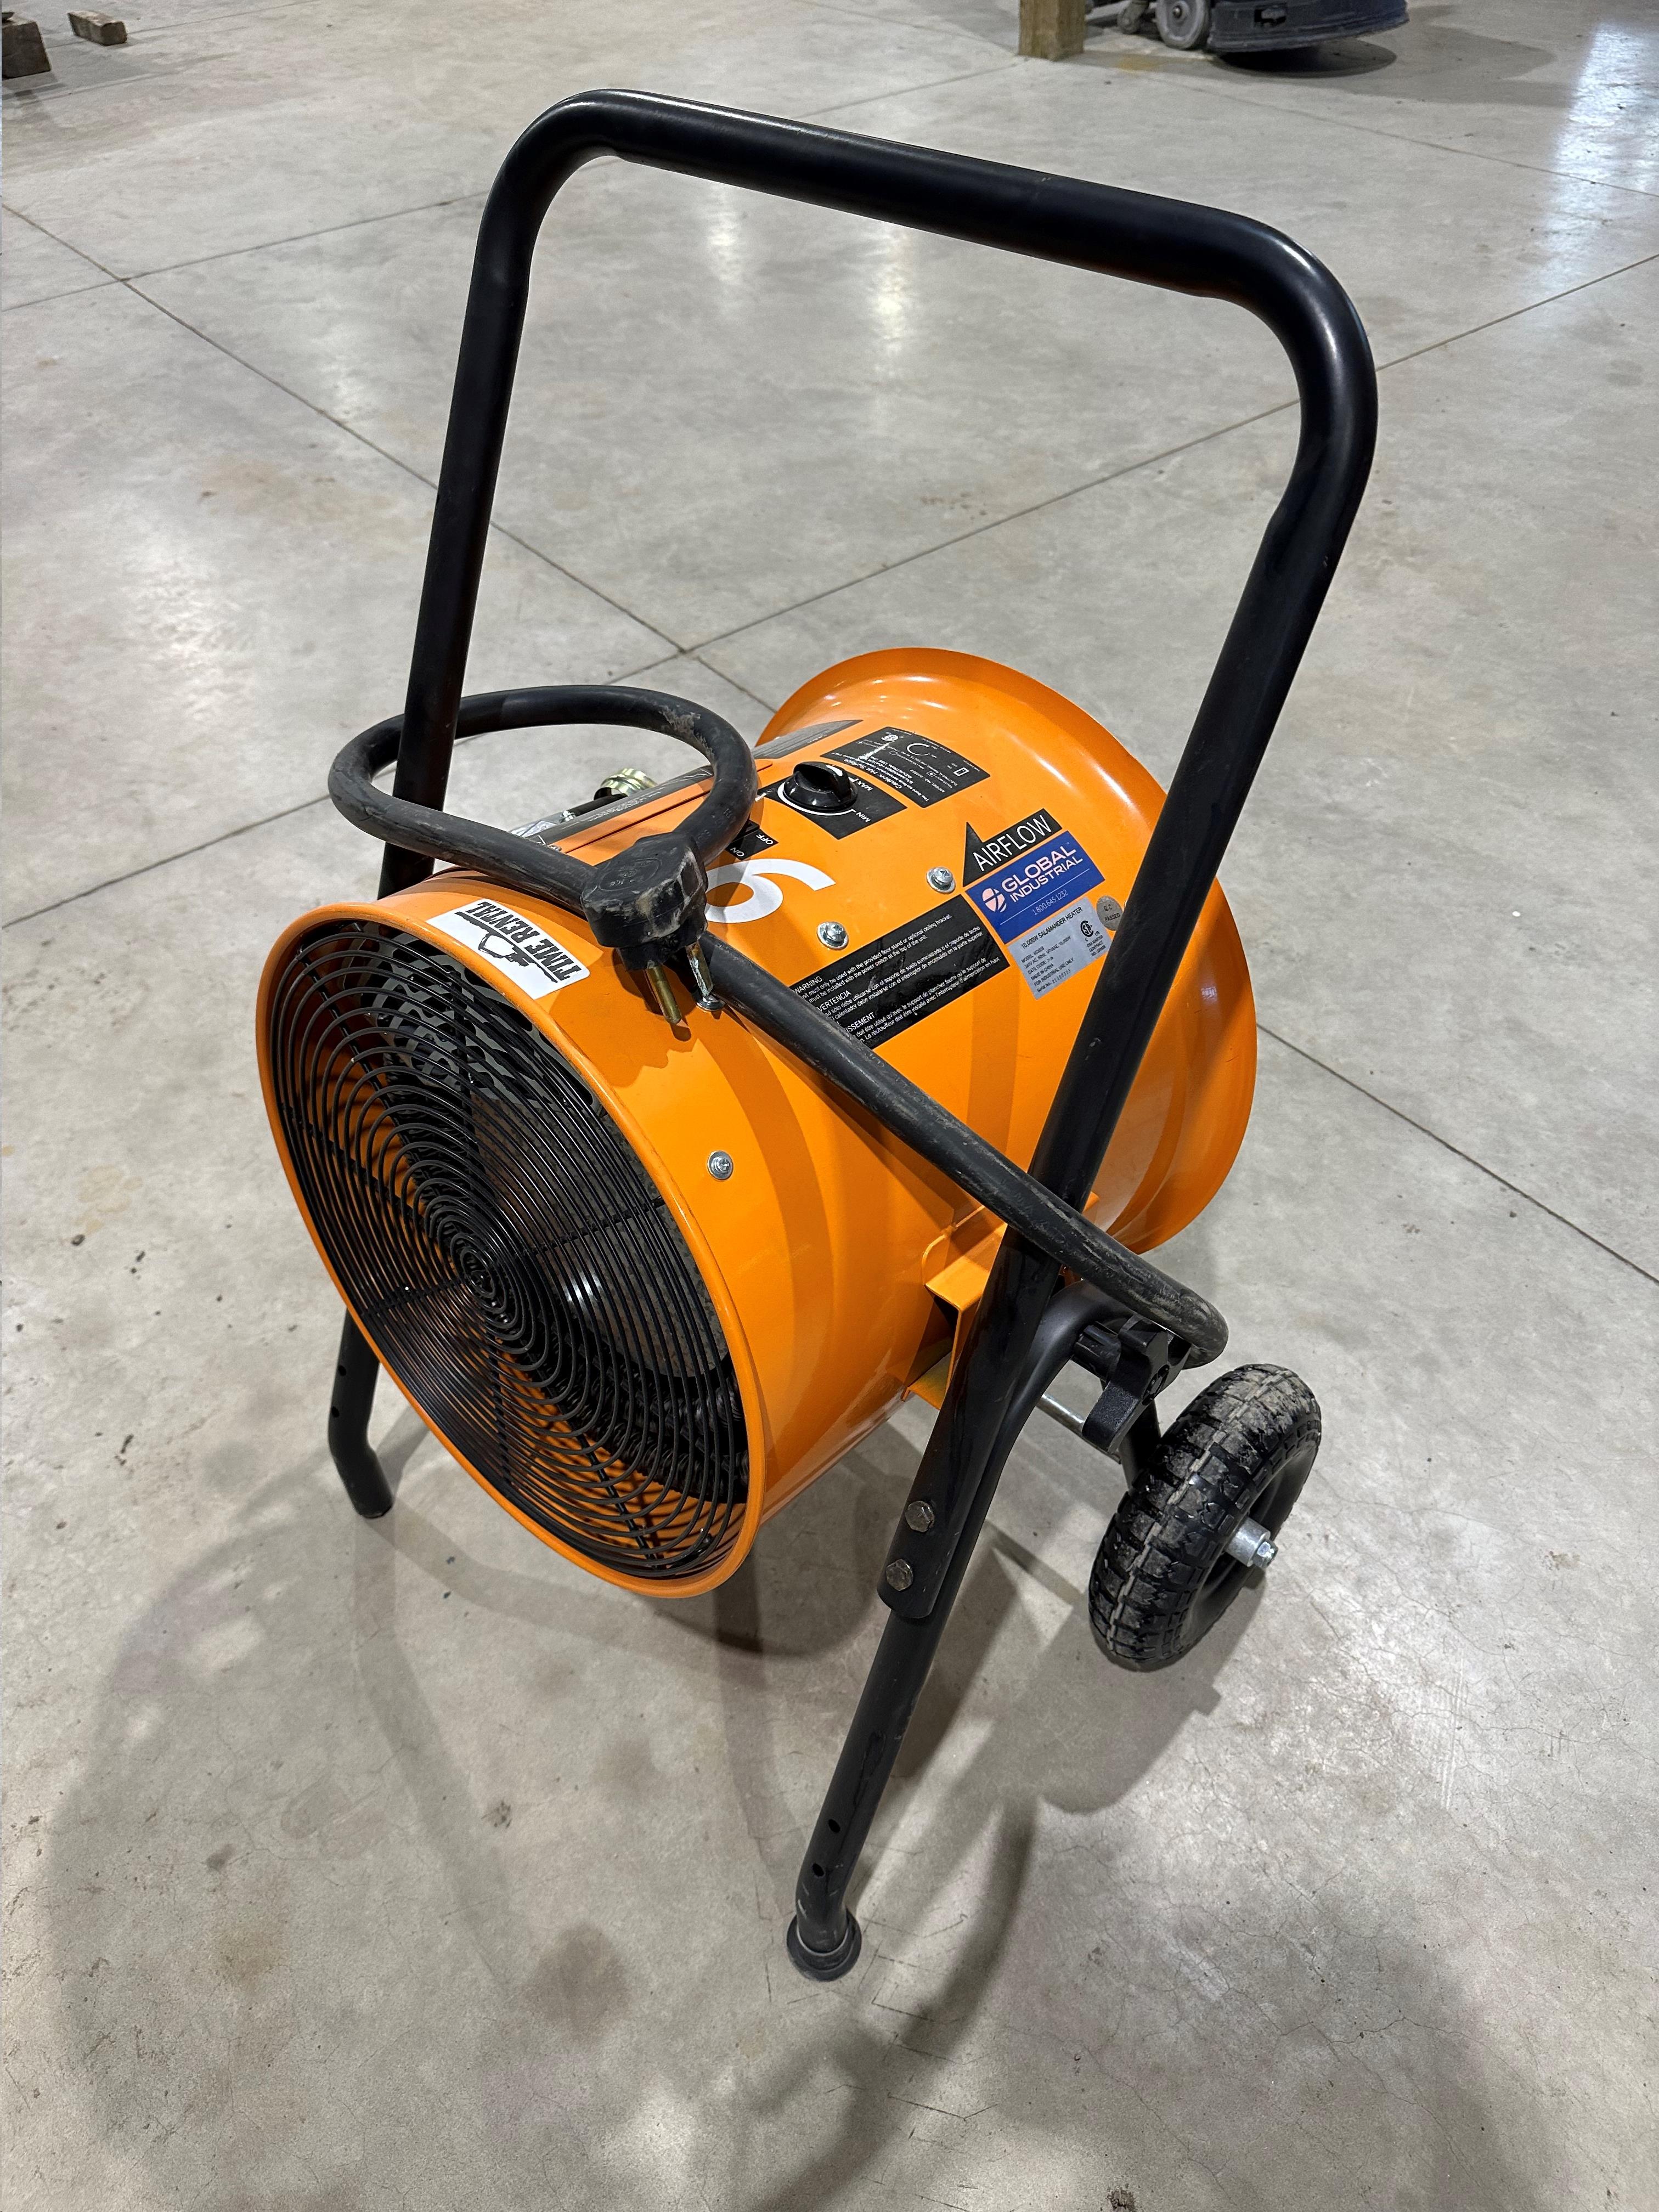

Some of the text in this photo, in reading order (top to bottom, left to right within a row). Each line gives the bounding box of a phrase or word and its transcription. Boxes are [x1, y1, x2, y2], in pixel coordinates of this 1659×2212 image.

[856, 781, 873, 791] MAX
[856, 812, 871, 822] MIN
[730, 847, 744, 856] ON
[756, 834, 774, 844] OFF
[973, 815, 1051, 872] AIRFLOW
[1001, 846, 1076, 893] GLOBAL
[1010, 856, 1083, 902] INDUSTRIAL
[1022, 907, 1082, 949] 10,000W SALAMANDER HEATER
[1104, 913, 1120, 922] PASSED
[466, 901, 582, 981] TIME RENTAL
[809, 986, 820, 996] must
[836, 971, 847, 980] used
[864, 952, 882, 966] provided
[891, 940, 903, 950] stand
[908, 929, 923, 940] optional
[923, 923, 937, 932] ceiling
[794, 977, 822, 995] WARNING
[809, 994, 821, 1003] must
[826, 980, 845, 992] installed
[861, 964, 874, 975] power
[875, 957, 888, 966] switch
[835, 1004, 857, 1019] calentador
[857, 998, 868, 1006] debe
[868, 986, 888, 1000] instalarse
[901, 967, 921, 981] interruptor
[928, 952, 947, 966] encendido
[957, 941, 968, 950] parte
[967, 932, 983, 943] superior
[841, 999, 853, 1007] debe
[853, 987, 871, 1001] utilizarse
[884, 972, 900, 983] soporte
[906, 962, 917, 970] suelo
[917, 949, 941, 964] suministrado
[949, 936, 964, 946] soporte
[968, 926, 980, 934] techo
[1031, 972, 1041, 980] MADE
[1044, 963, 1054, 972] CHINA
[1041, 968, 1059, 982] INDUSTRIAL
[1065, 957, 1074, 966] ONLY
[817, 990, 851, 1012] VERTENCIA
[874, 1017, 886, 1026] utilisé
[907, 995, 923, 1007] support
[928, 982, 945, 995] plancher
[966, 961, 981, 972] support
[846, 1012, 874, 1032] ISSEMENT
[871, 1020, 894, 1036] réchauffeur
[912, 1001, 926, 1012] installé
[926, 995, 936, 1003] avec
